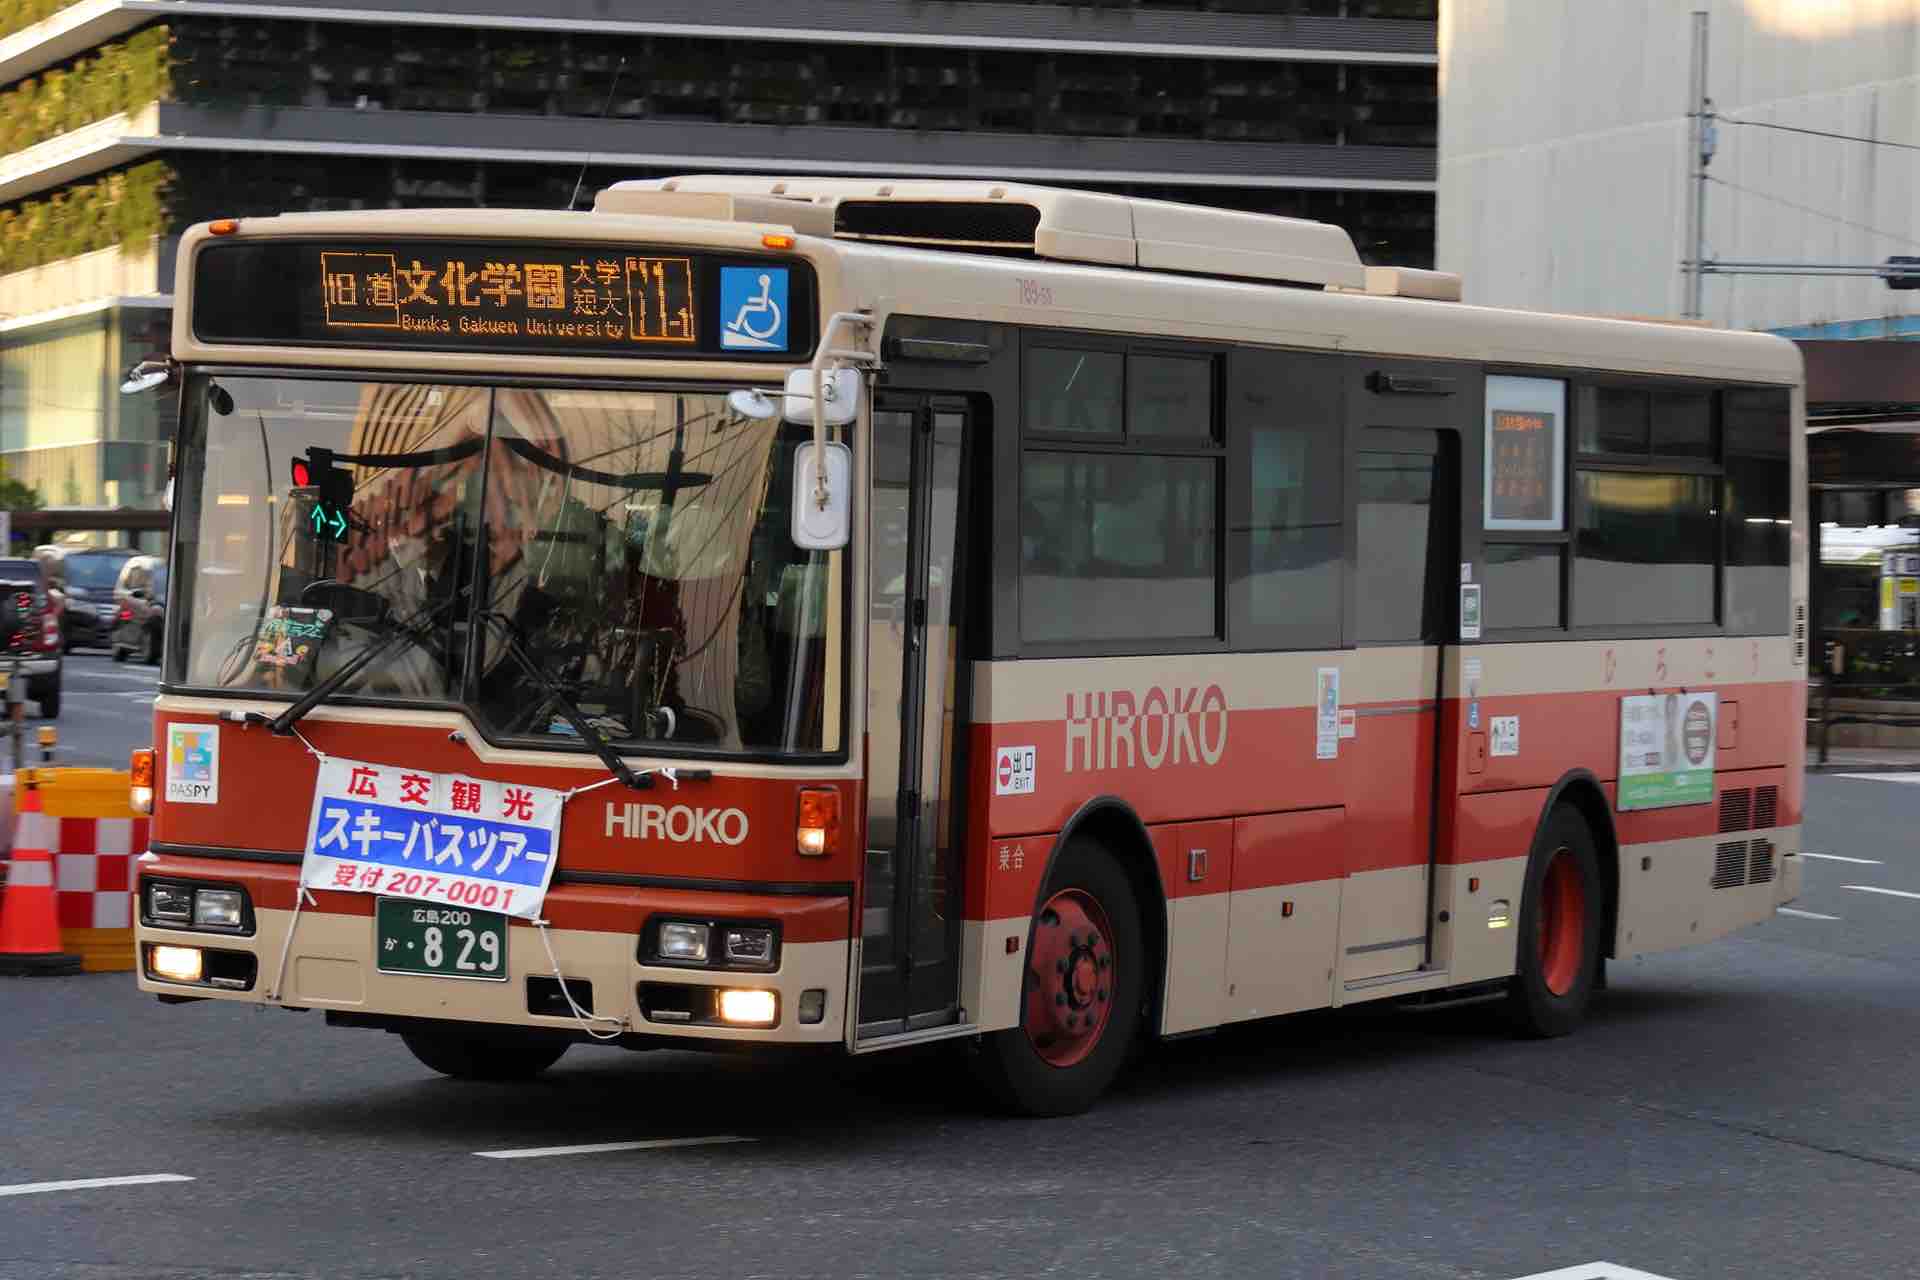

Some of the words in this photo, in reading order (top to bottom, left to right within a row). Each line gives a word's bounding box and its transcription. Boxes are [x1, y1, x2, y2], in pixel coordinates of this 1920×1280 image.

[397, 259, 566, 309] 文化学園
[569, 257, 622, 286] 大学
[327, 271, 395, 307] 旧道
[572, 288, 624, 317] 短大
[401, 313, 451, 333] Bunka
[458, 315, 519, 336] Gakuen
[526, 317, 625, 340] University
[1063, 683, 1228, 775] HIROKO
[1013, 751, 1034, 775] 出口
[346, 765, 534, 823] 広交観光
[1014, 776, 1032, 791] EXIT
[604, 801, 750, 846] HIROKO
[318, 807, 550, 876] スキーバスツアー
[999, 844, 1024, 872] 乗合
[331, 862, 384, 888] 受付
[387, 872, 515, 911] 207-0001
[412, 908, 472, 927] 広島200
